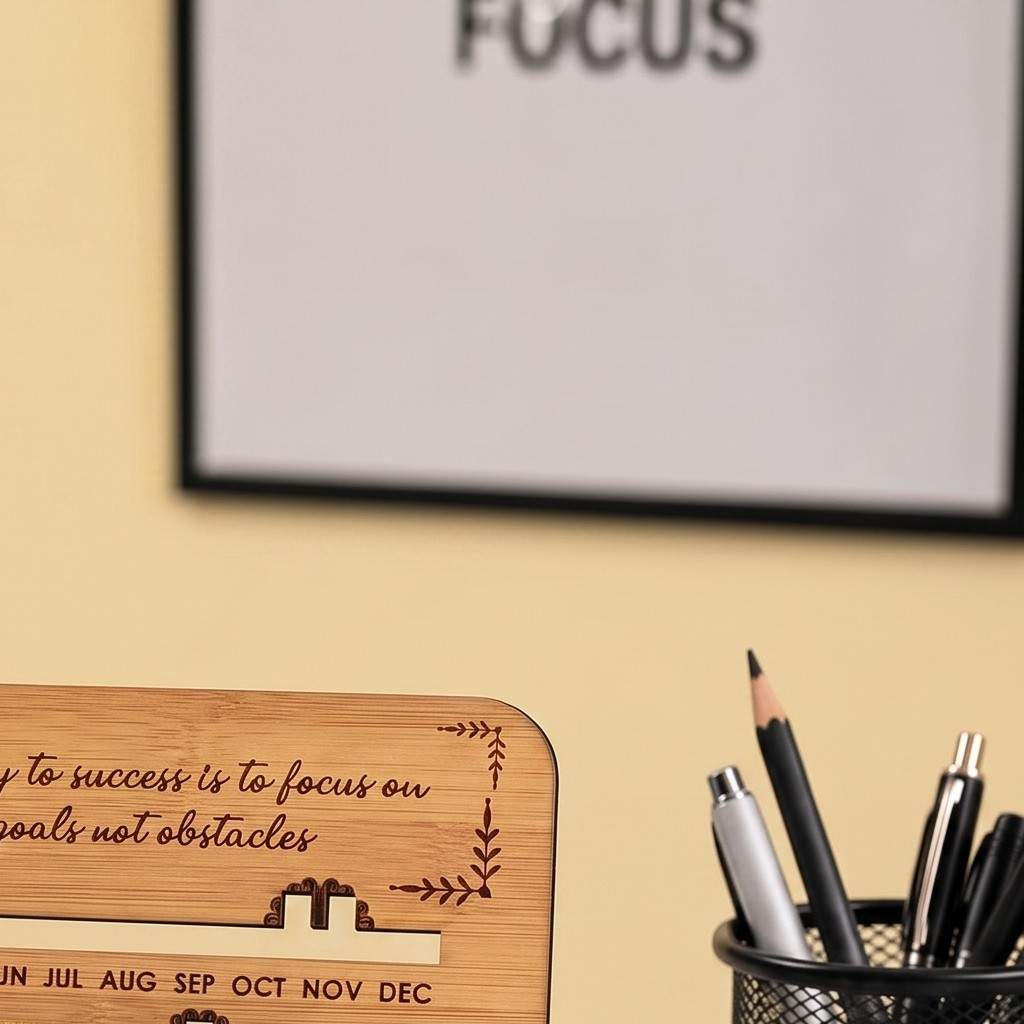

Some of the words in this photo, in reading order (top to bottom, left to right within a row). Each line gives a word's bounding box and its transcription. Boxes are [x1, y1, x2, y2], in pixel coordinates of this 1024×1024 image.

[456, 0, 759, 72] FOCUS
[28, 752, 63, 785] to
[71, 766, 191, 792] success
[198, 765, 230, 793] is
[239, 760, 275, 792] to
[277, 760, 376, 805] focus
[382, 780, 430, 798] on
[92, 811, 162, 844] not
[155, 810, 317, 852] obstacles
[43, 968, 82, 988] JUL
[100, 971, 156, 992] AUG
[174, 973, 214, 994] SEP
[232, 976, 286, 997] OCT
[303, 980, 362, 1000] NOV
[380, 983, 431, 1004] DEC
